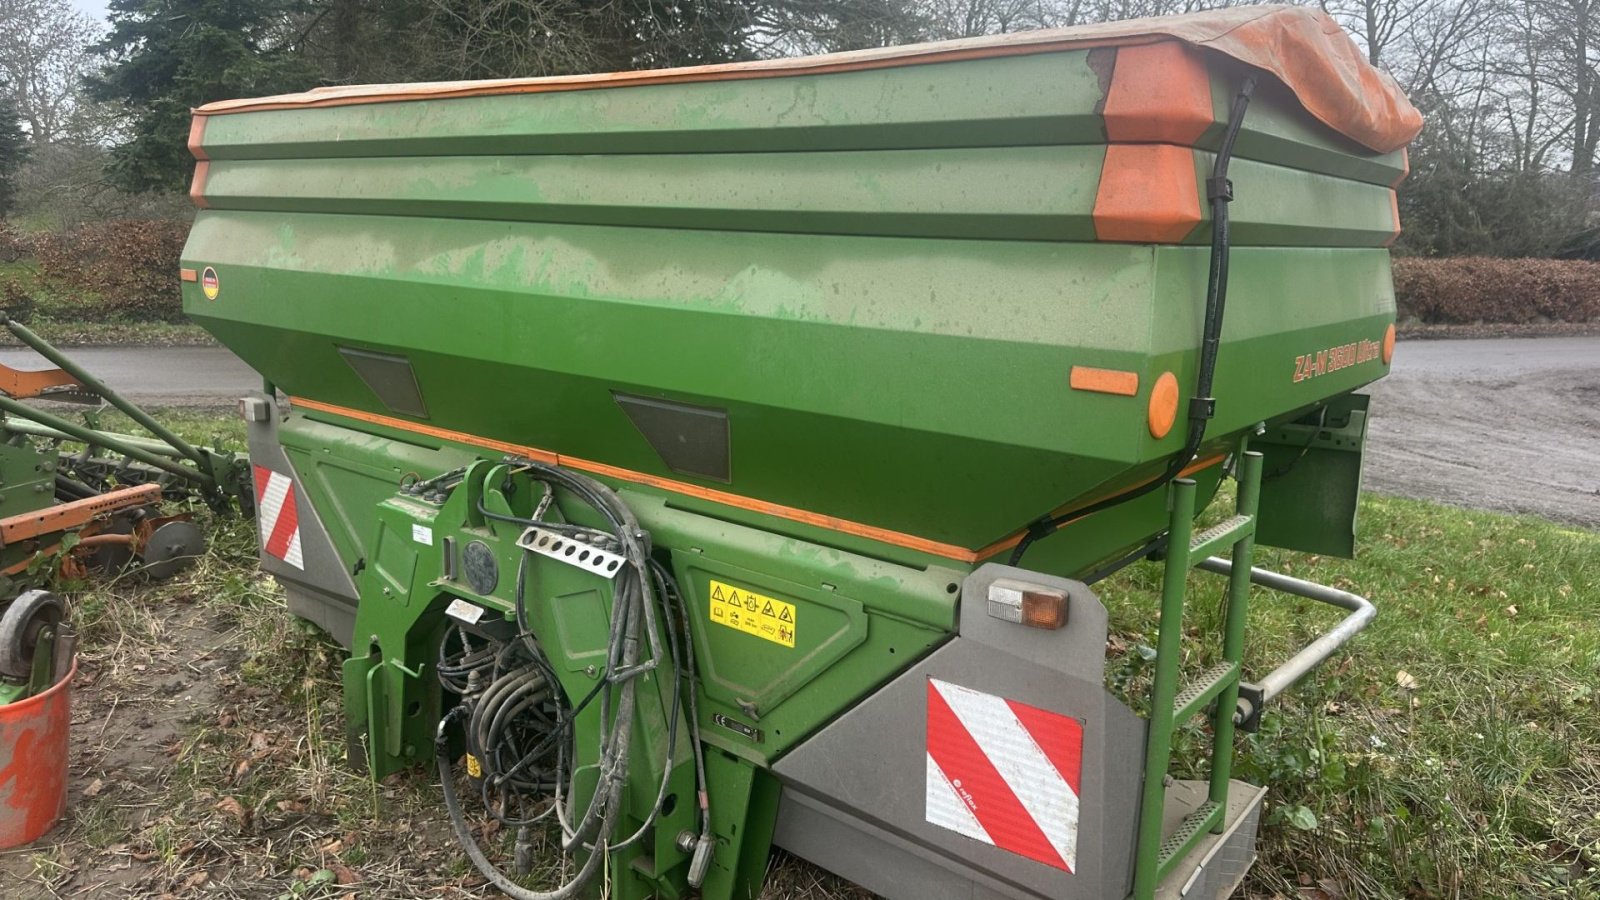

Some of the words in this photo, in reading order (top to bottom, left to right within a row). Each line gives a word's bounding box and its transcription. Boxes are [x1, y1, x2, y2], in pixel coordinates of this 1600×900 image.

[1293, 349, 1328, 383] ZA-M
[1327, 342, 1357, 373] 3600
[1356, 338, 1380, 364] Ultra
[959, 788, 978, 811] reflex
